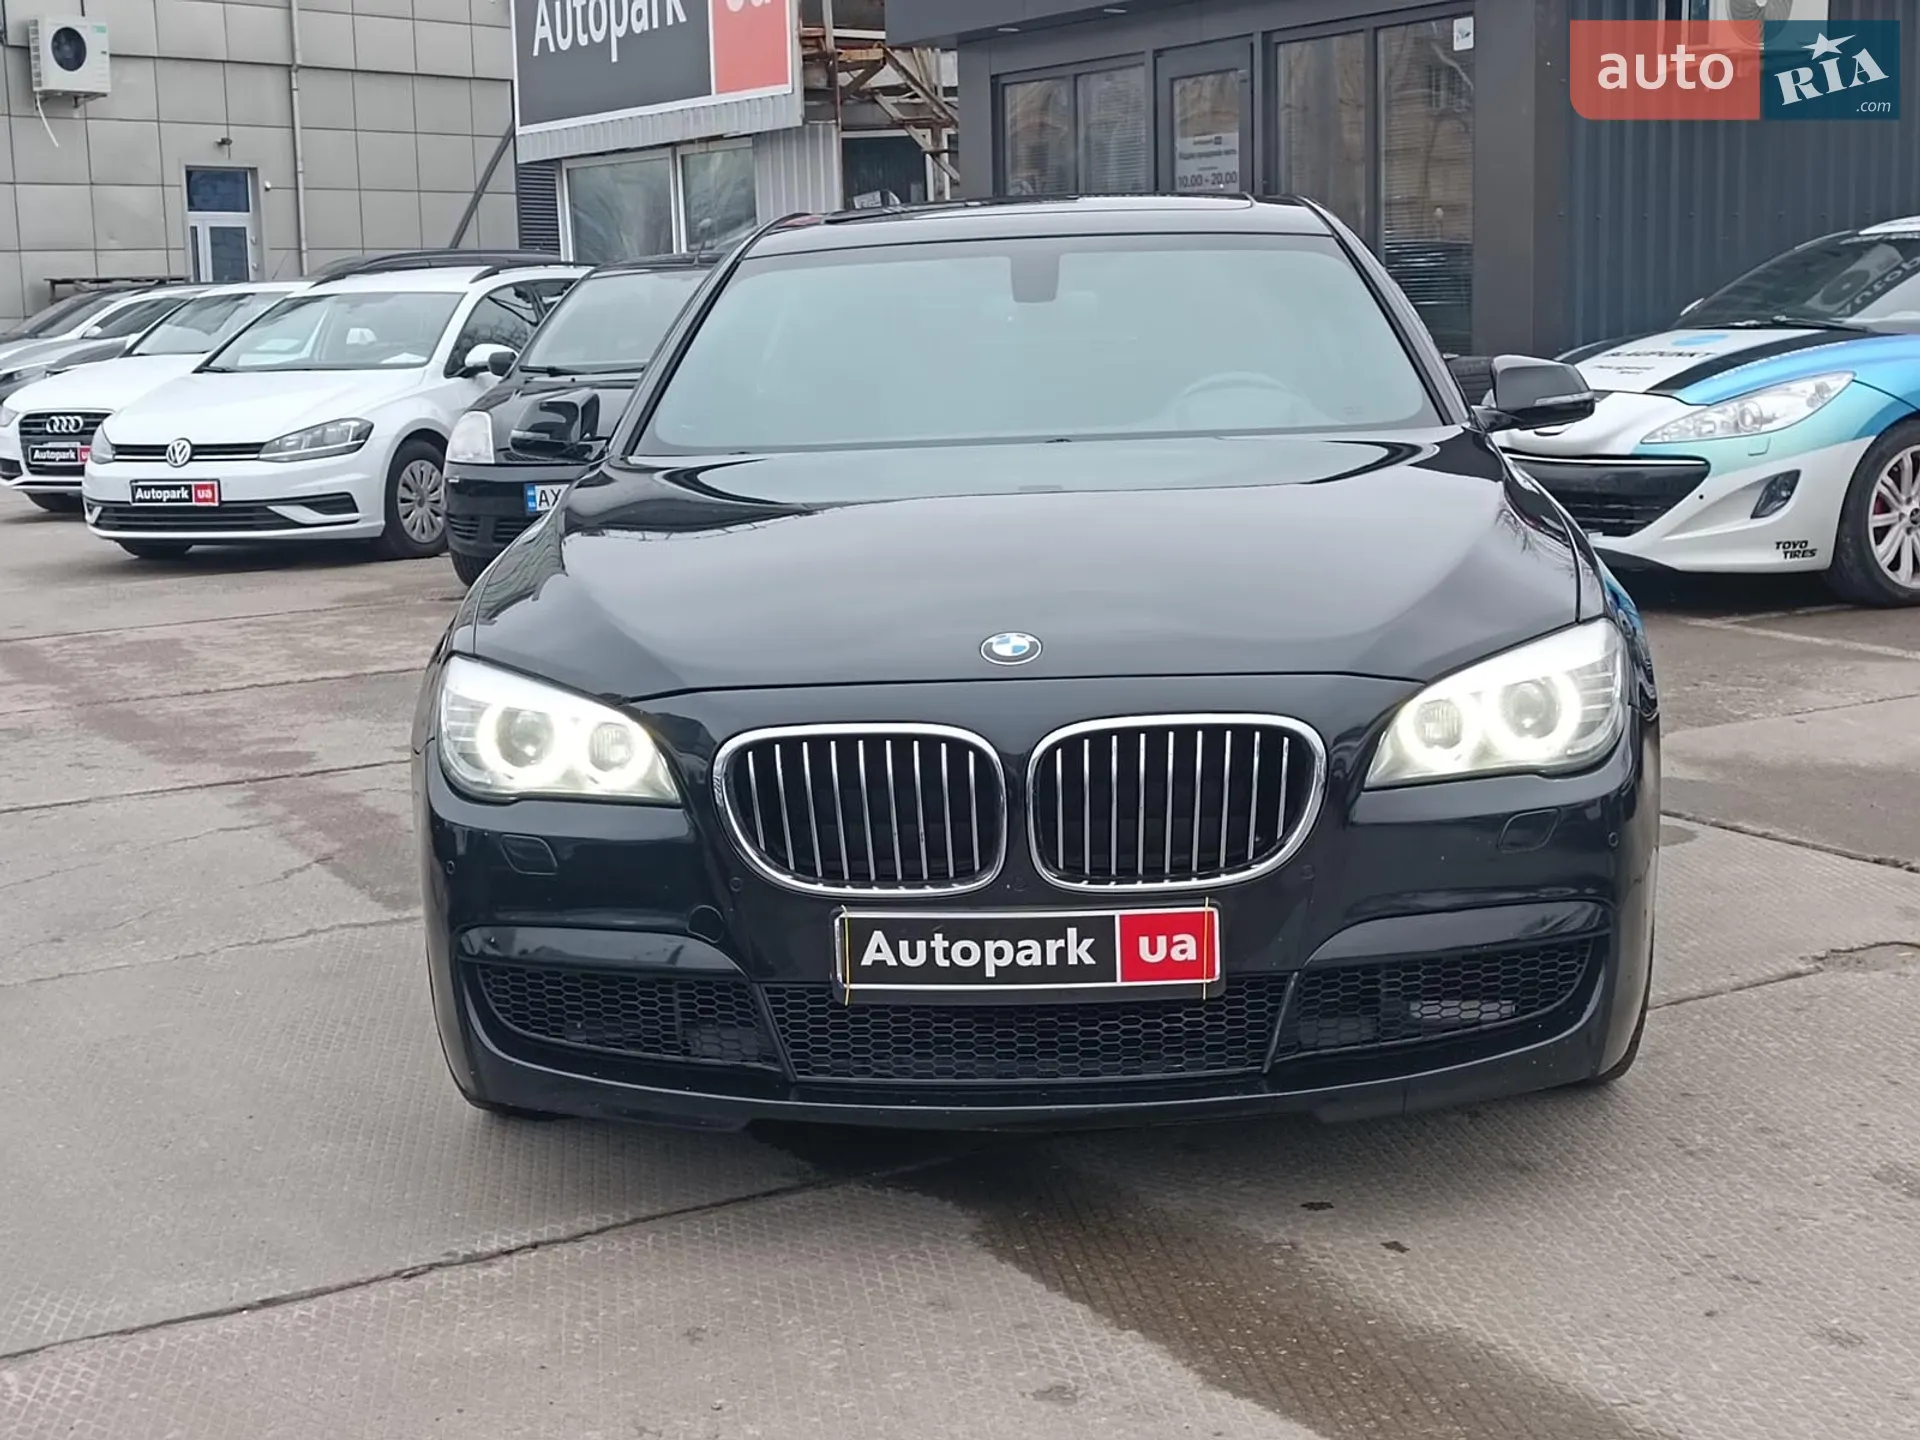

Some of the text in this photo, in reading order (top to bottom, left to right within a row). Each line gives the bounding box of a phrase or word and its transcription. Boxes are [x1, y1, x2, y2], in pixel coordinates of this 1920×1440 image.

[33, 449, 76, 462] Autopark
[135, 487, 213, 502] Autopark ua
[1775, 540, 1808, 549] TOYO
[1783, 549, 1817, 559] TIRES
[860, 927, 1197, 977] Autopark ua
